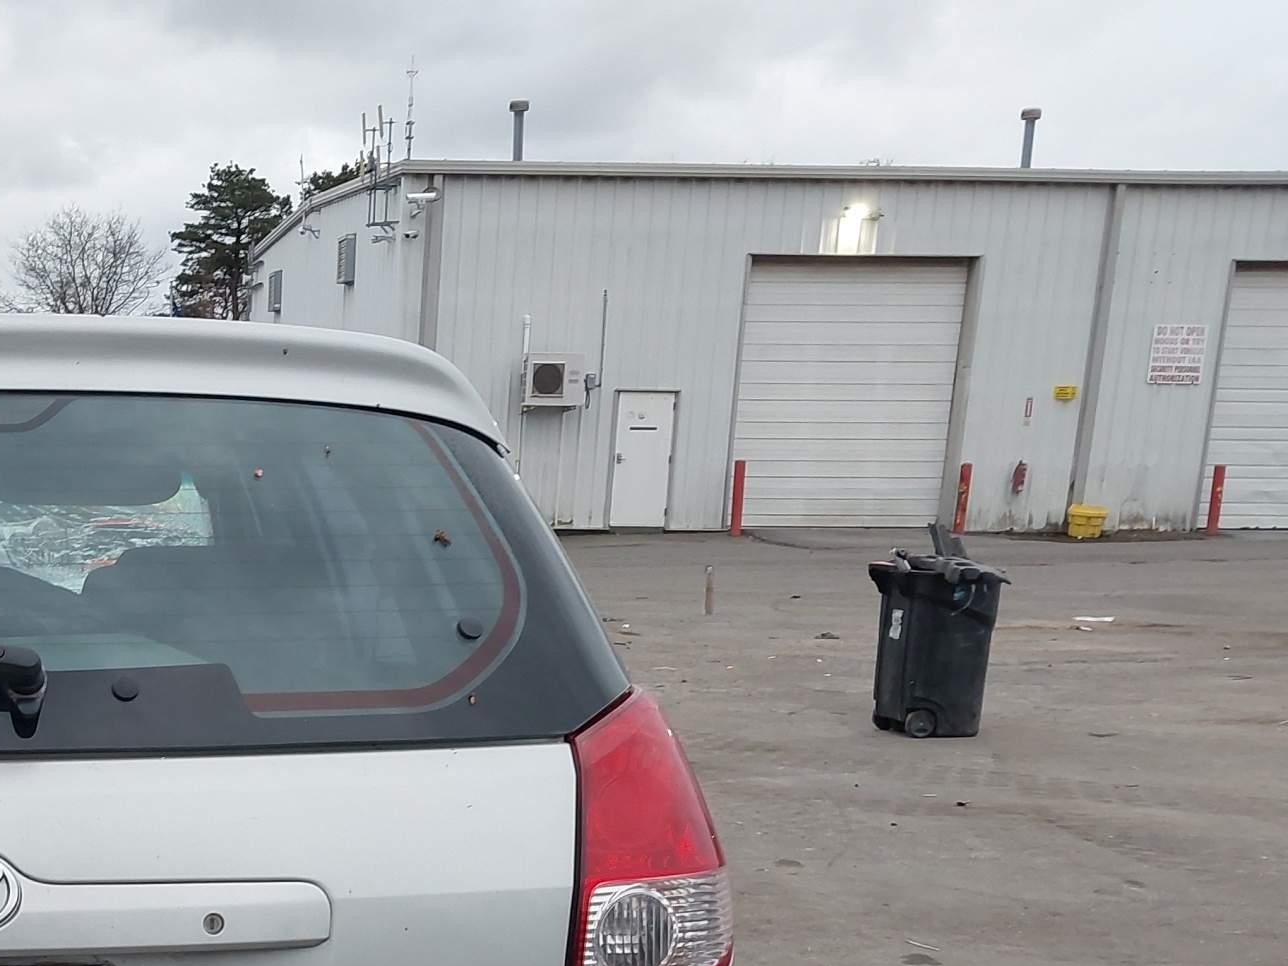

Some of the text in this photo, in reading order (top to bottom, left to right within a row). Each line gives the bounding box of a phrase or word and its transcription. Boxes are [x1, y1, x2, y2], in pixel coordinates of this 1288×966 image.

[1157, 326, 1205, 337] DO NOT OPEN
